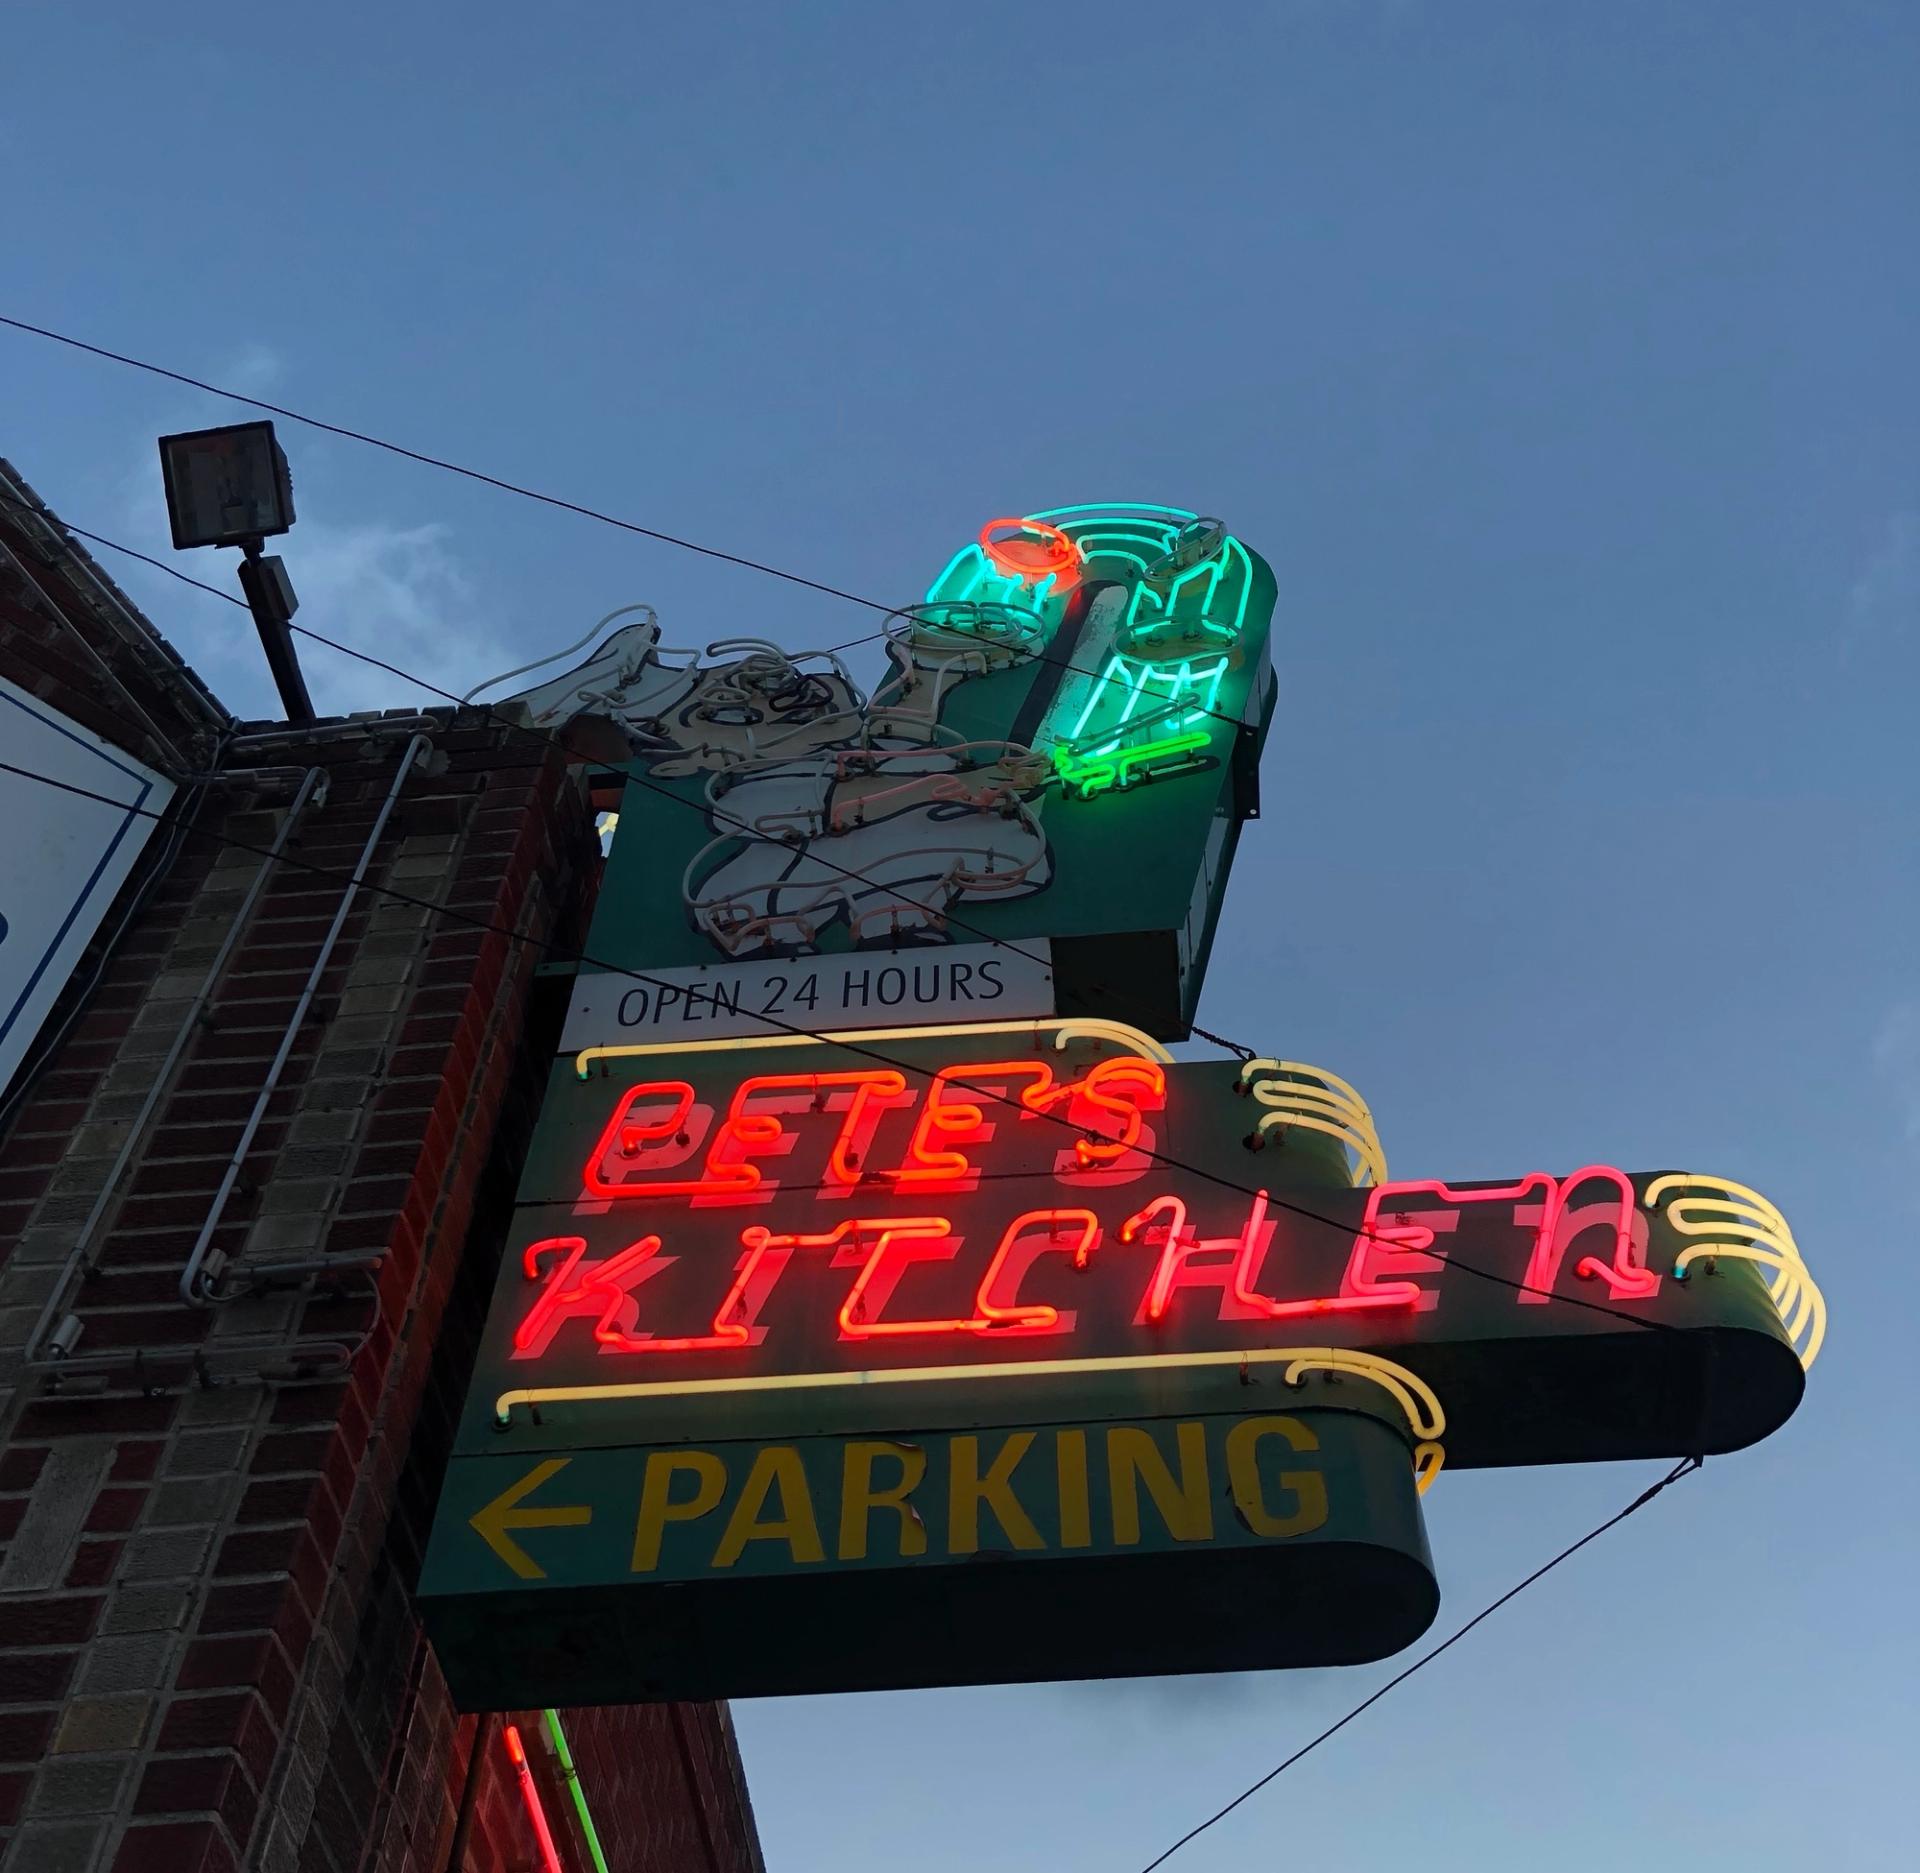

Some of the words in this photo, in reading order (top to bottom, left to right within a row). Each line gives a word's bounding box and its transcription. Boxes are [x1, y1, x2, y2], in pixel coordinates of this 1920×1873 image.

[617, 981, 739, 1027] OPEN
[763, 974, 821, 1014] 24
[842, 960, 1005, 1009] HOURS
[572, 1056, 1167, 1216] PETE'S
[509, 1164, 1663, 1361] KITCHEN
[630, 1415, 1330, 1573] PARKING
